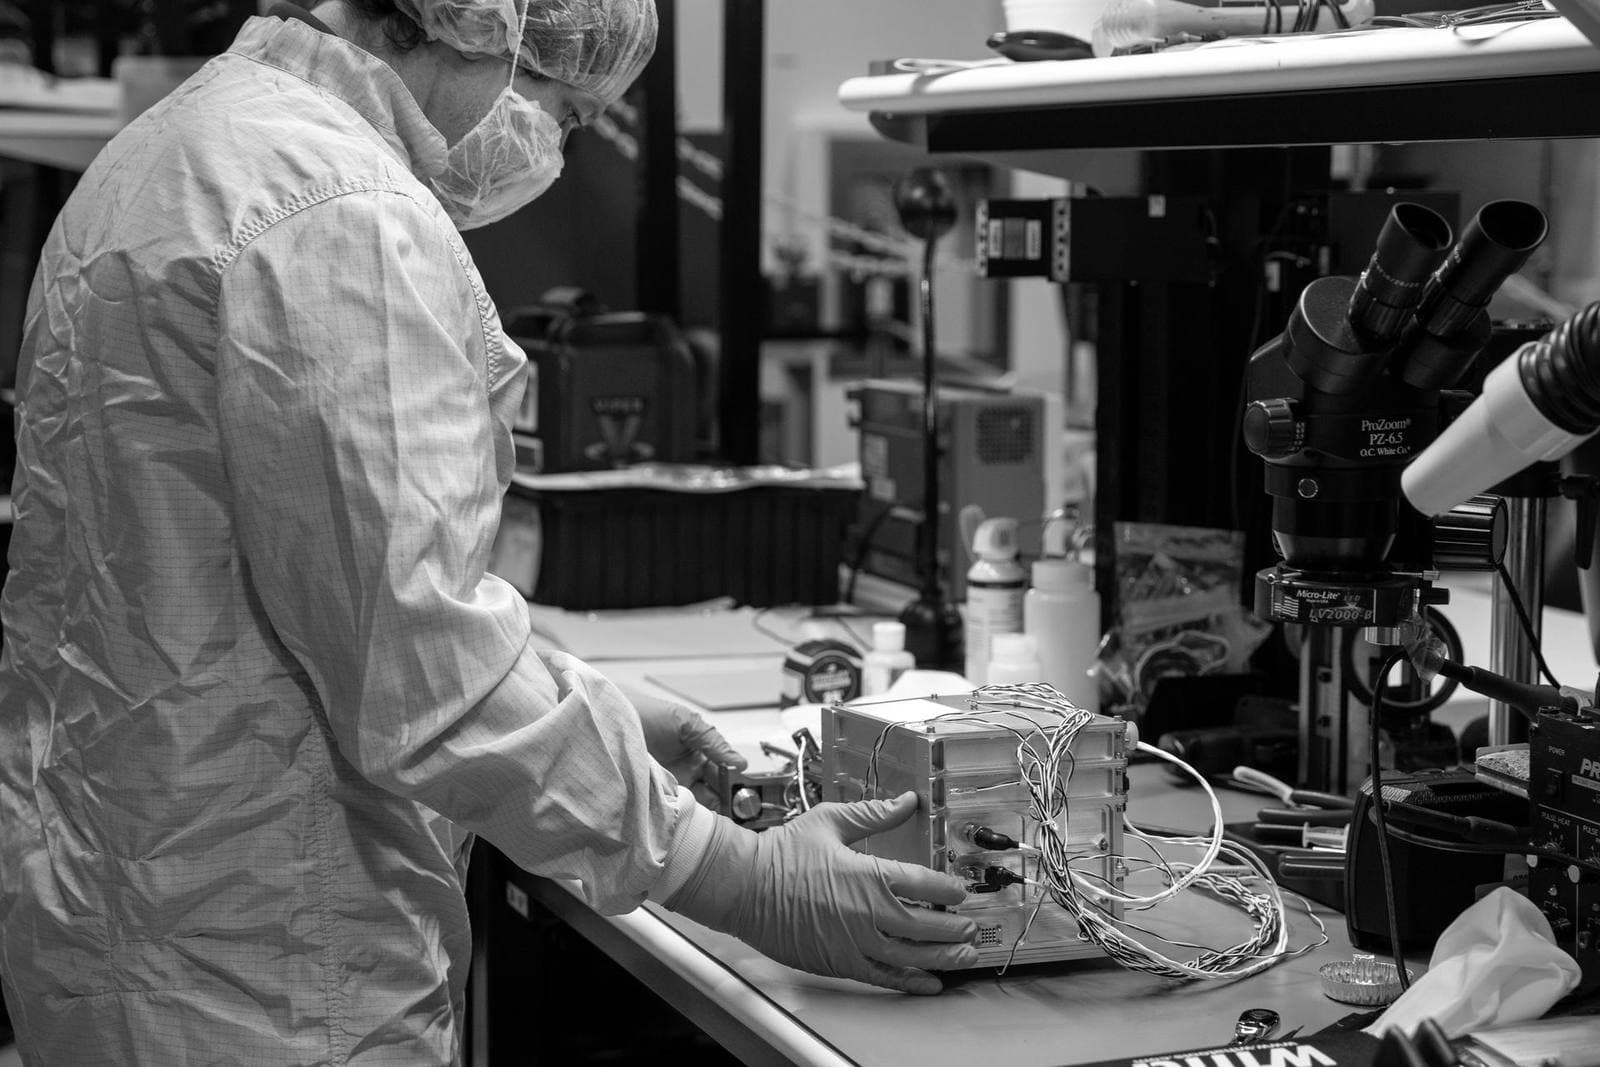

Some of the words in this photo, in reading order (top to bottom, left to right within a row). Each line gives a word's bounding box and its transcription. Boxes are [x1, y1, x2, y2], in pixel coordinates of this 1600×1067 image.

[1369, 432, 1404, 446] PZ-6.5
[1296, 589, 1338, 600] Micro-Lite
[1308, 607, 1373, 621] LV2000-B
